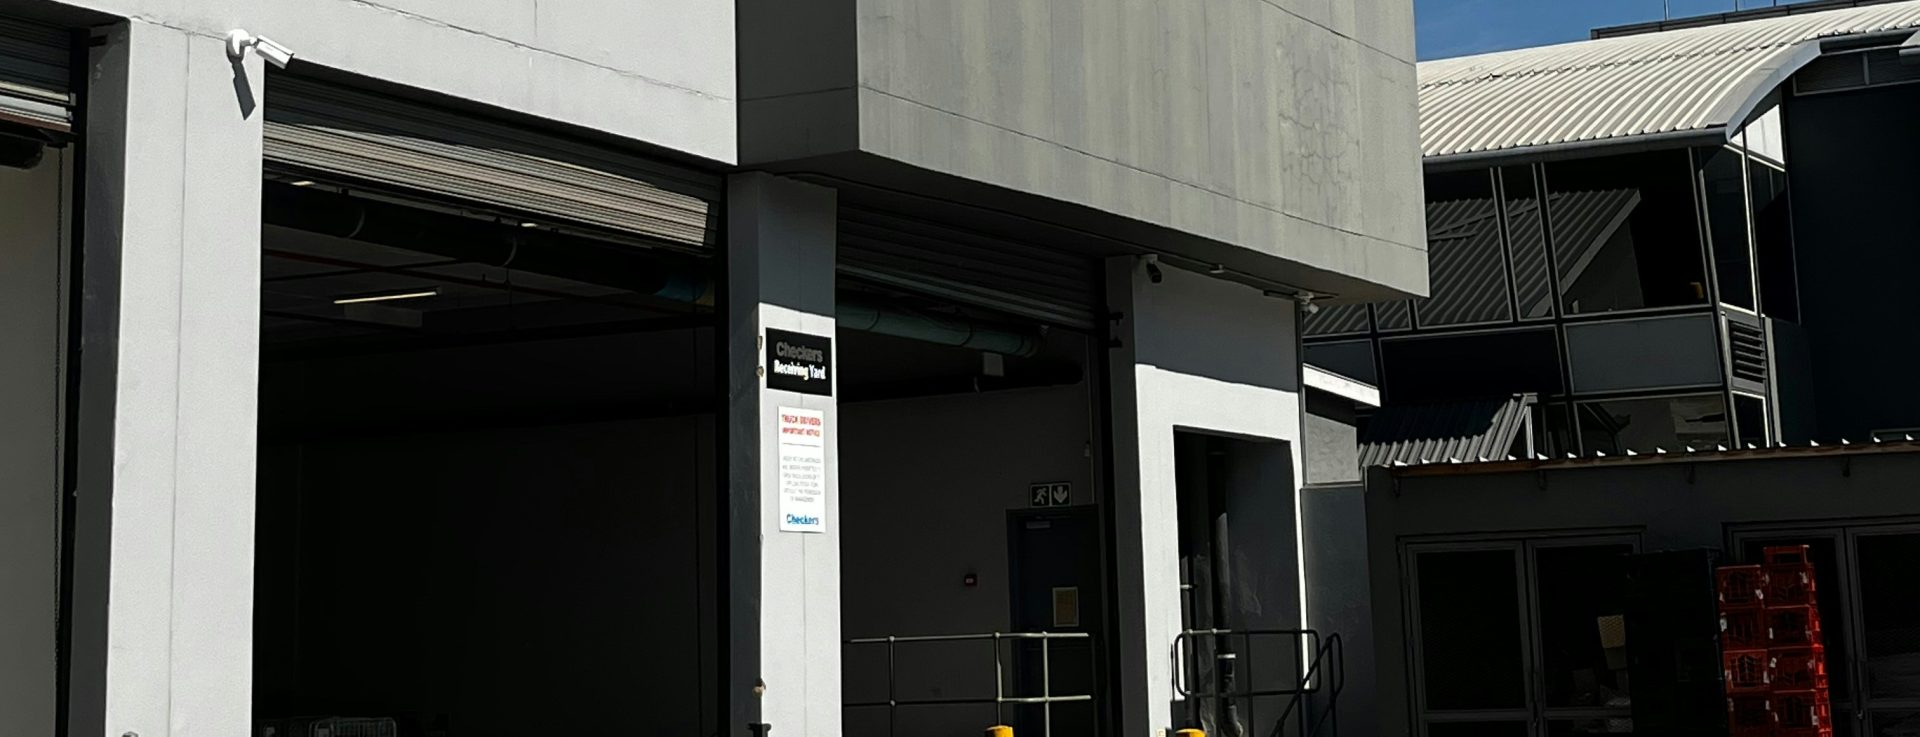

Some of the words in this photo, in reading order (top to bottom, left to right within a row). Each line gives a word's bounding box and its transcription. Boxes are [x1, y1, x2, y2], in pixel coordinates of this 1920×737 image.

[776, 341, 823, 363] Checkers
[774, 359, 809, 380] Receiving
[809, 364, 826, 379] Yard
[786, 513, 819, 525] Checkers
